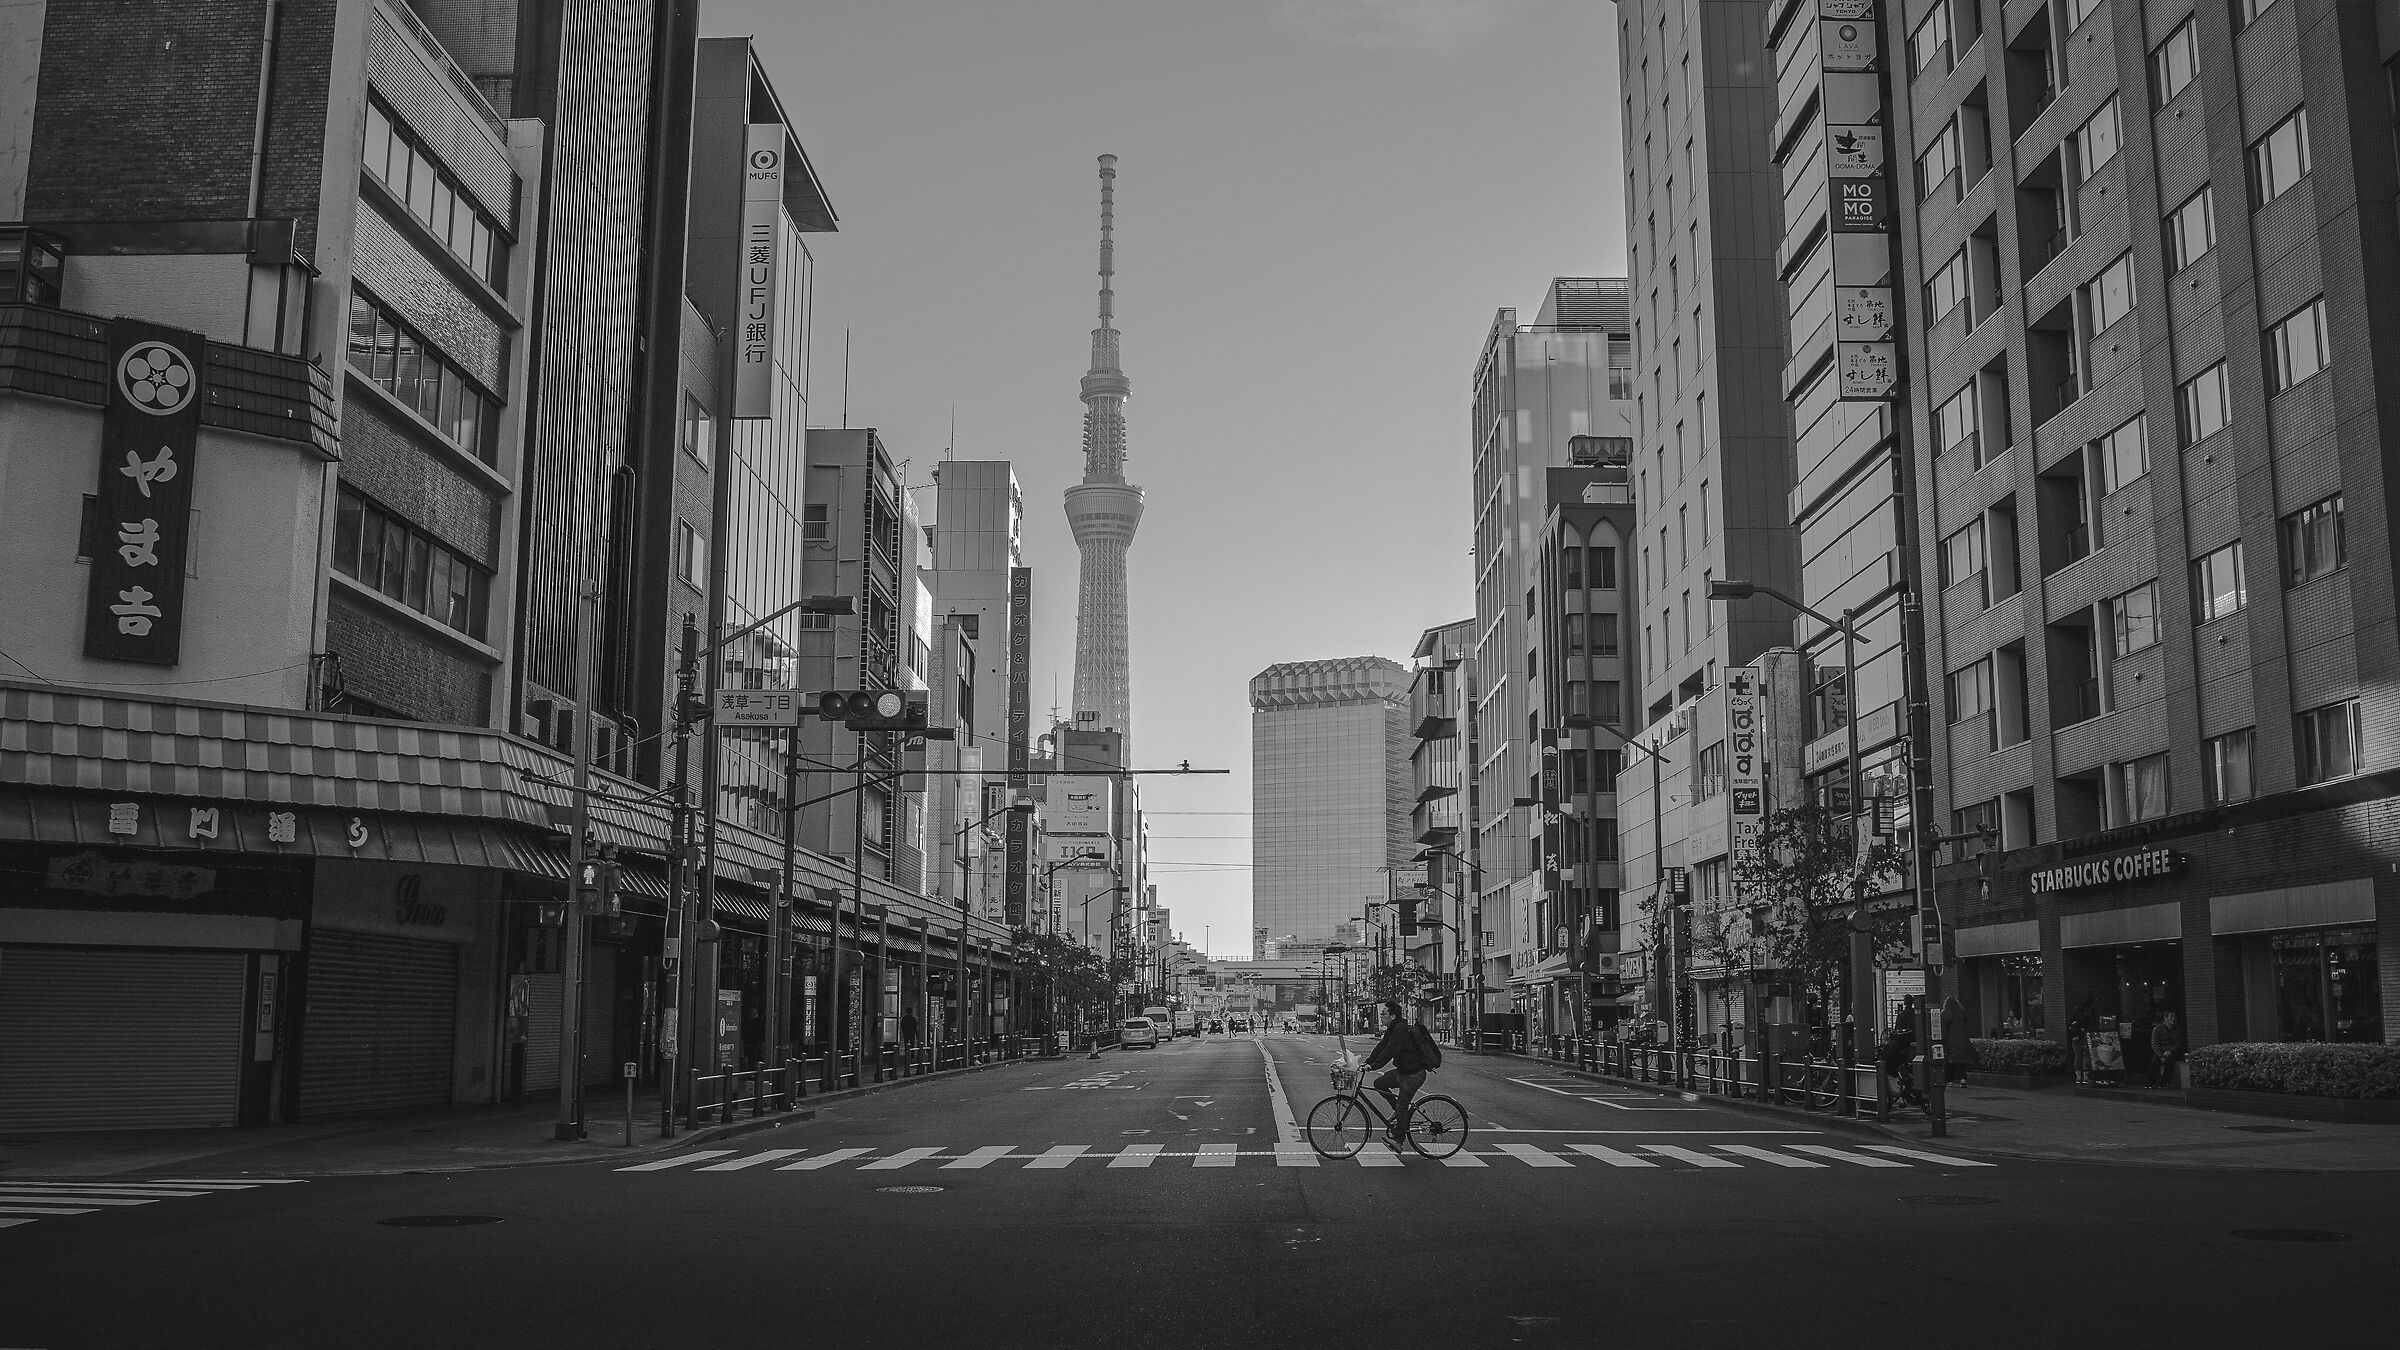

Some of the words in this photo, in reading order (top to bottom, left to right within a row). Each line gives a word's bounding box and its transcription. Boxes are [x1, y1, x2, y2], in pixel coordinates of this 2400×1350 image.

[749, 172, 778, 180] MUFG
[1843, 184, 1872, 197] MO
[1844, 202, 1873, 215] MO
[745, 225, 771, 364] 三菱UFJ銀行
[1845, 386, 1877, 394] 24時間営業
[110, 446, 178, 636] やま吉
[1012, 575, 1027, 780] カラオケ&パーティー館
[722, 694, 790, 710] 浅草一丁目
[735, 712, 769, 721] Asakusa
[773, 712, 777, 720] 1
[1732, 705, 1755, 776] ぱぱす
[108, 802, 368, 848] 雷門通り
[1736, 822, 1760, 835] Tax
[1010, 820, 1023, 915] カラオケ館
[2031, 859, 2109, 894] STARBUCKS
[2113, 848, 2171, 881] COFFEE
